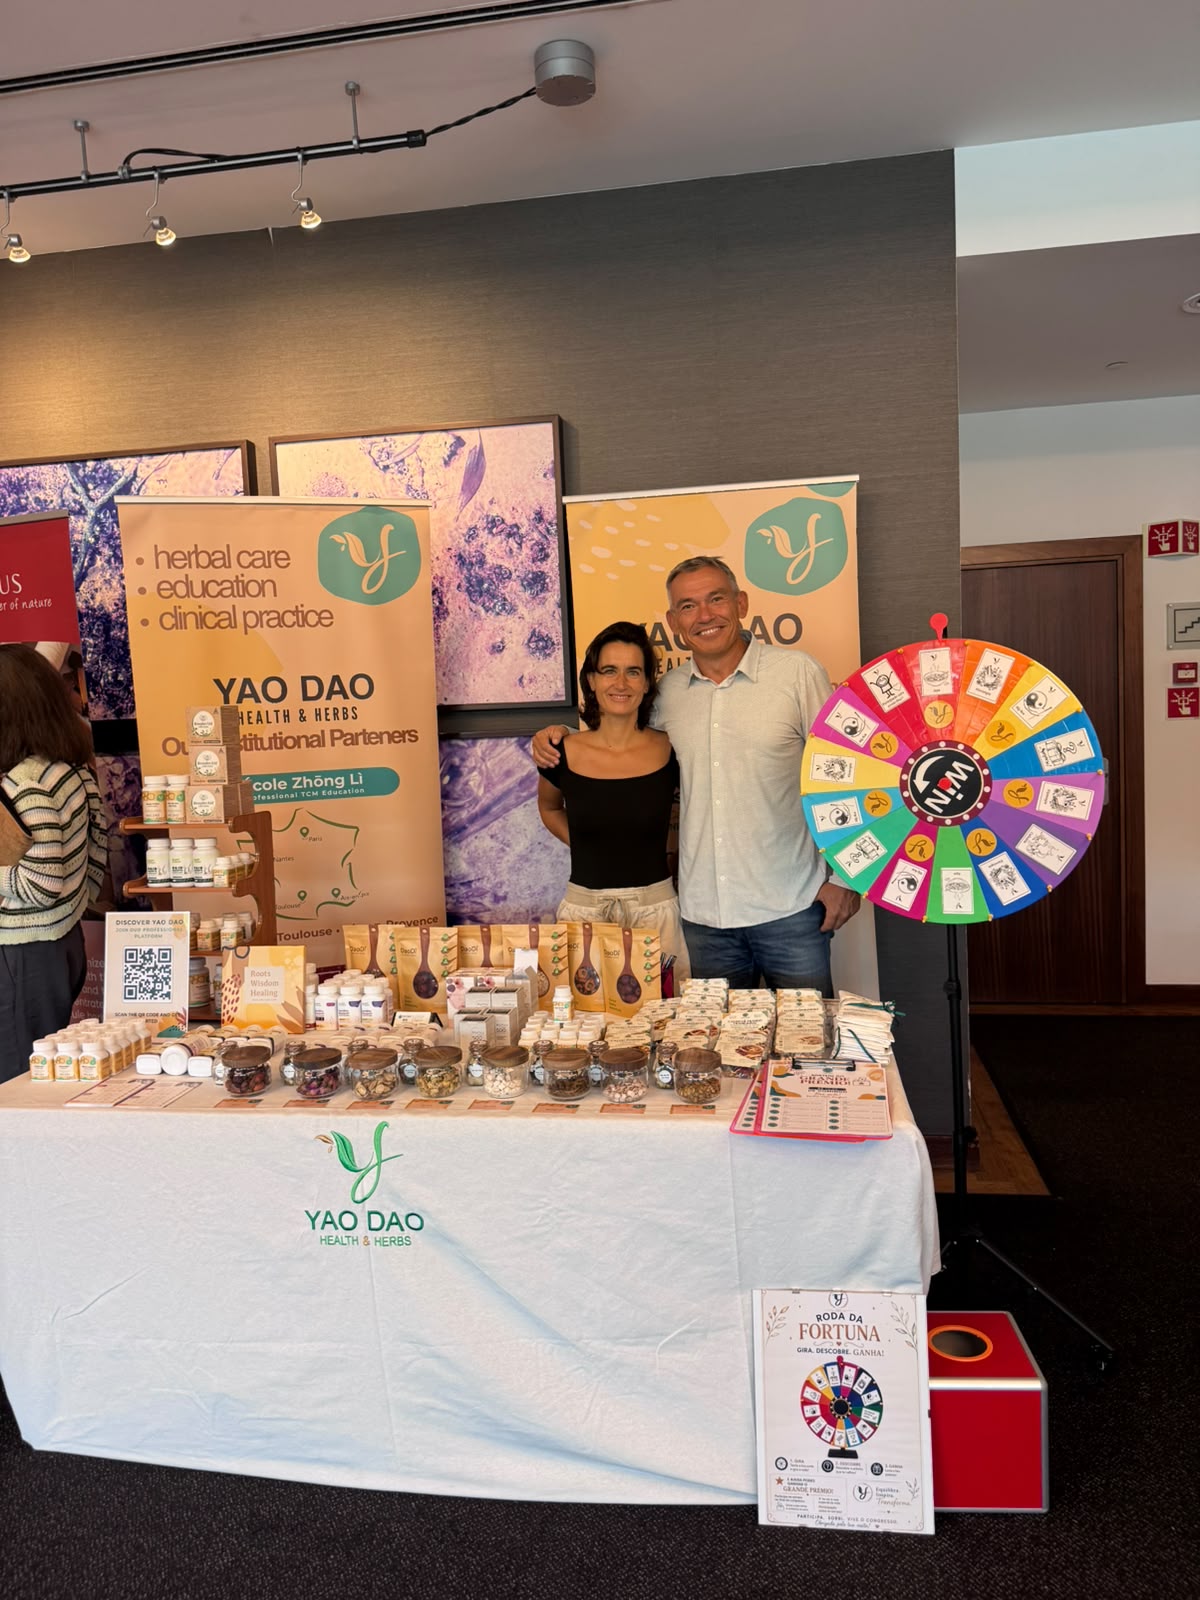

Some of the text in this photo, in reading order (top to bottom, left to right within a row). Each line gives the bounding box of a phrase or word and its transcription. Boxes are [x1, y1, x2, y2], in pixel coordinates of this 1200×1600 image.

[154, 544, 291, 569] herbal care
[156, 574, 277, 599] education
[10, 597, 19, 610] of
[22, 598, 52, 609] nature
[159, 604, 333, 635] clinical practice
[214, 673, 375, 705] YAO DAO
[238, 707, 358, 725] HEALTH & HERBS
[330, 727, 419, 748] Parteners
[245, 772, 363, 792] cole Zhōng Lì
[253, 792, 298, 801] ofessional
[322, 787, 365, 796] Education
[278, 927, 333, 942] Toulouse
[250, 989, 278, 998] Healing
[304, 1210, 425, 1232] YAO DAO
[320, 1235, 412, 1247] HEALTH & HERBS
[816, 1312, 863, 1324] RODA DA
[799, 1323, 880, 1342] FORTUNA
[853, 1349, 884, 1357] GANHA!
[783, 1485, 809, 1493] GRANDE
